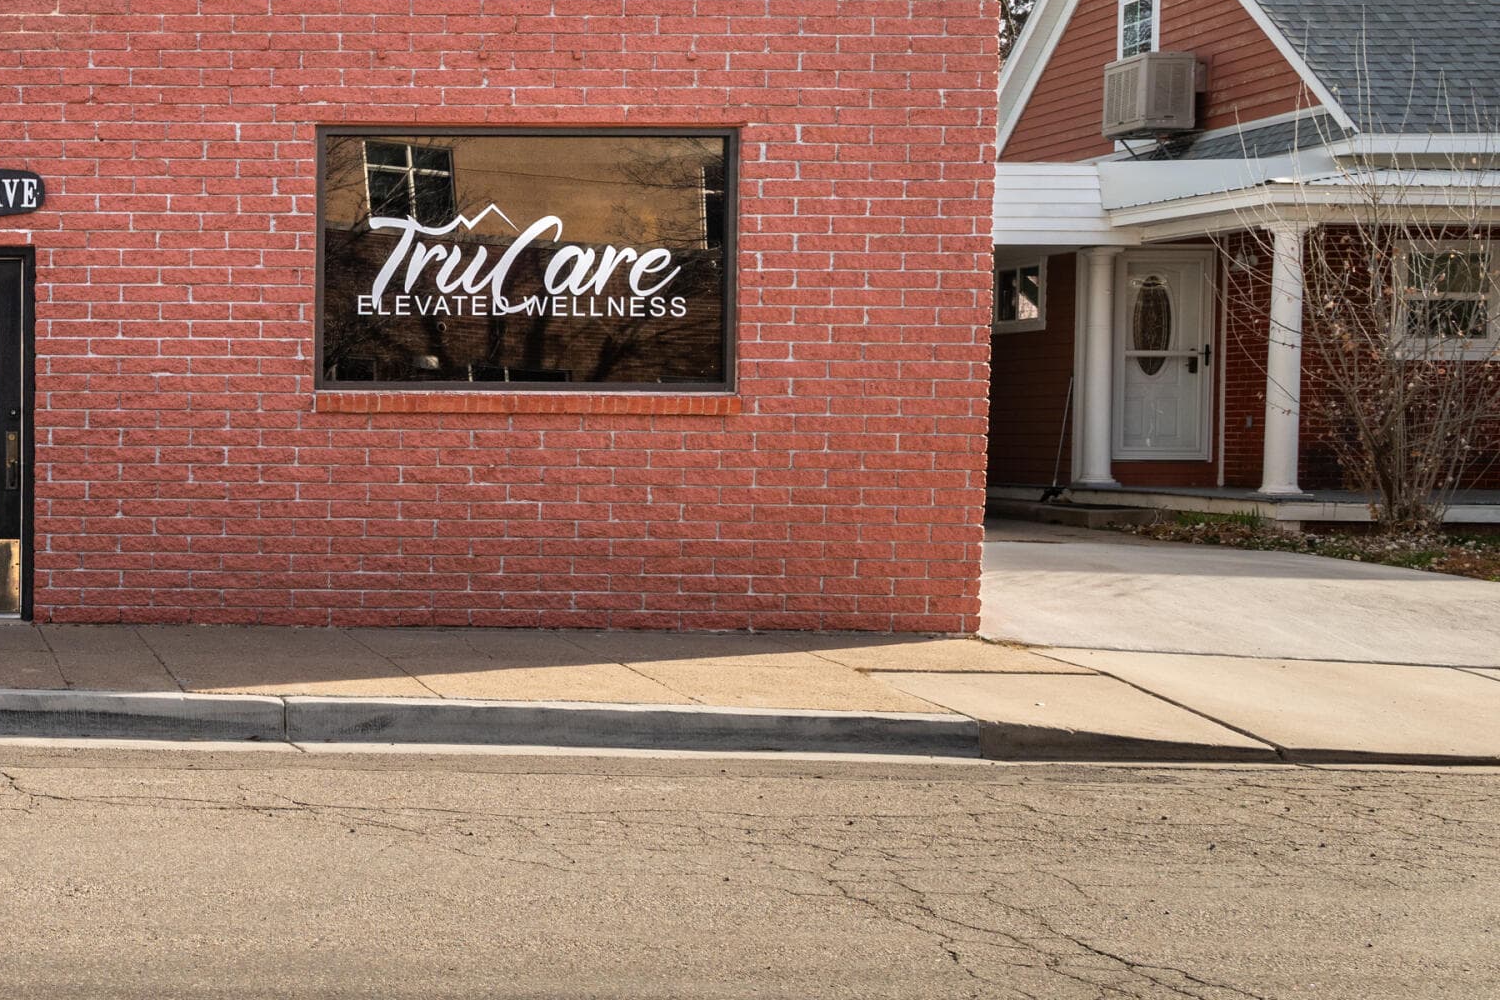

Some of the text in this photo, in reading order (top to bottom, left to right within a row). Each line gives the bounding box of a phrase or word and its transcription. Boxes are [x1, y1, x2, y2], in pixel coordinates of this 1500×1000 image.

[368, 213, 682, 314] TruCare
[357, 295, 688, 317] ELEVATED WELLNESS
